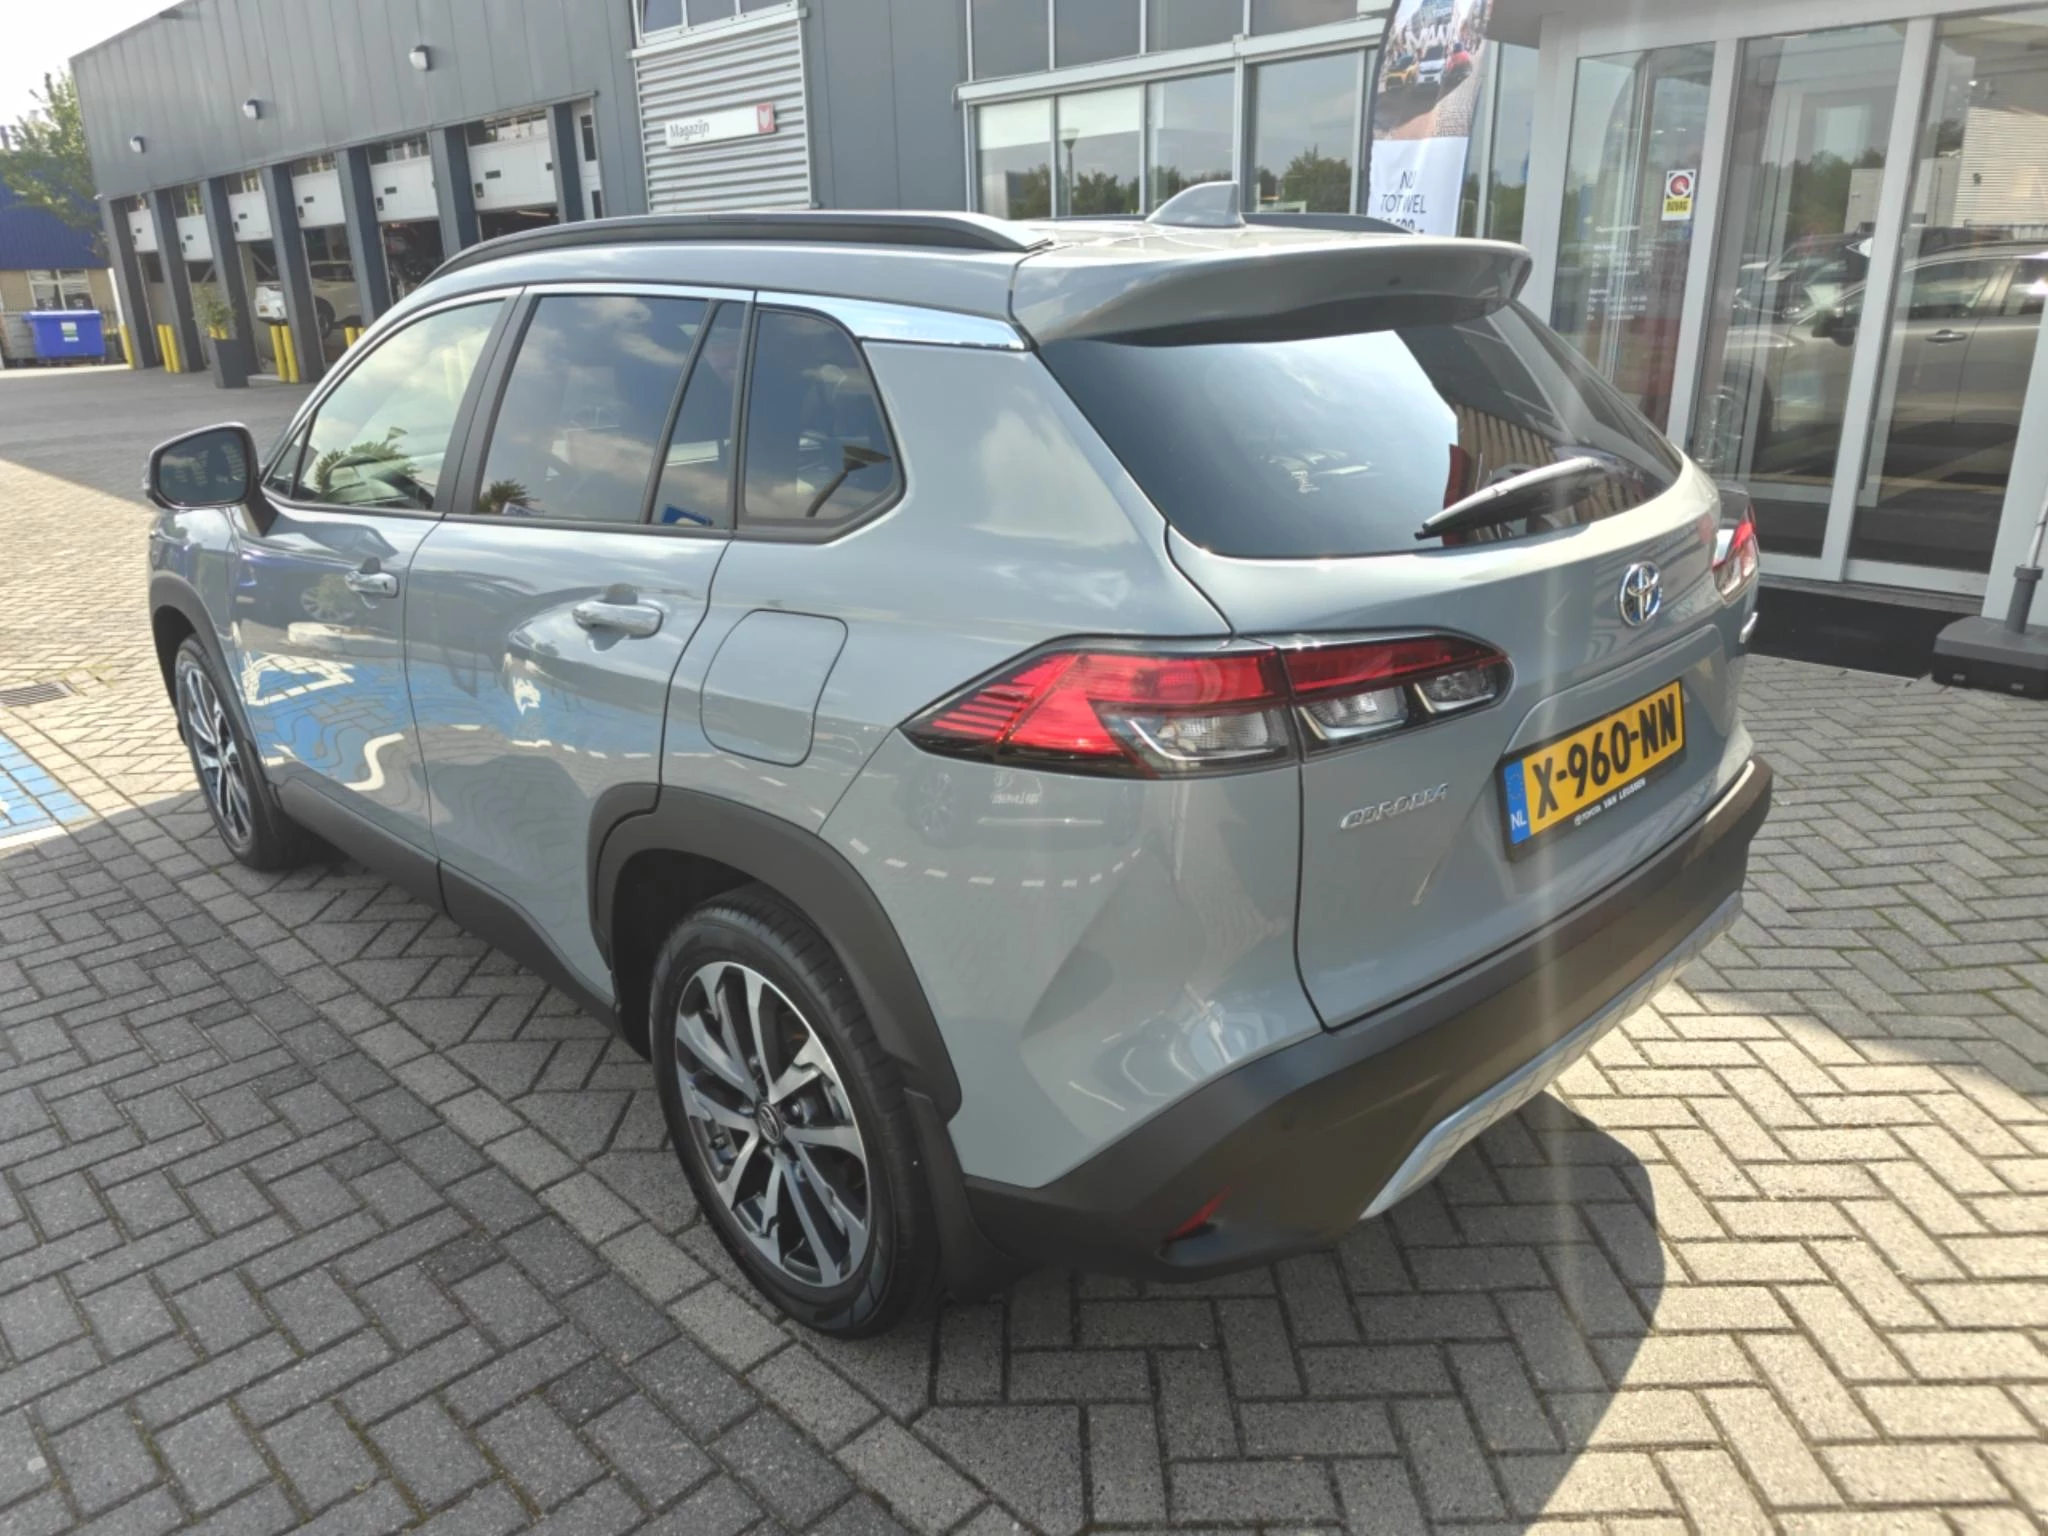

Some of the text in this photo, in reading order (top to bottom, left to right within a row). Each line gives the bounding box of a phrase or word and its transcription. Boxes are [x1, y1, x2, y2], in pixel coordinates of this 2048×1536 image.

[669, 119, 710, 140] Magazijn
[1380, 193, 1404, 213] TOT
[1532, 692, 1677, 820] X-960-NN
[1340, 782, 1448, 829] COROLLA
[1510, 808, 1528, 831] NL
